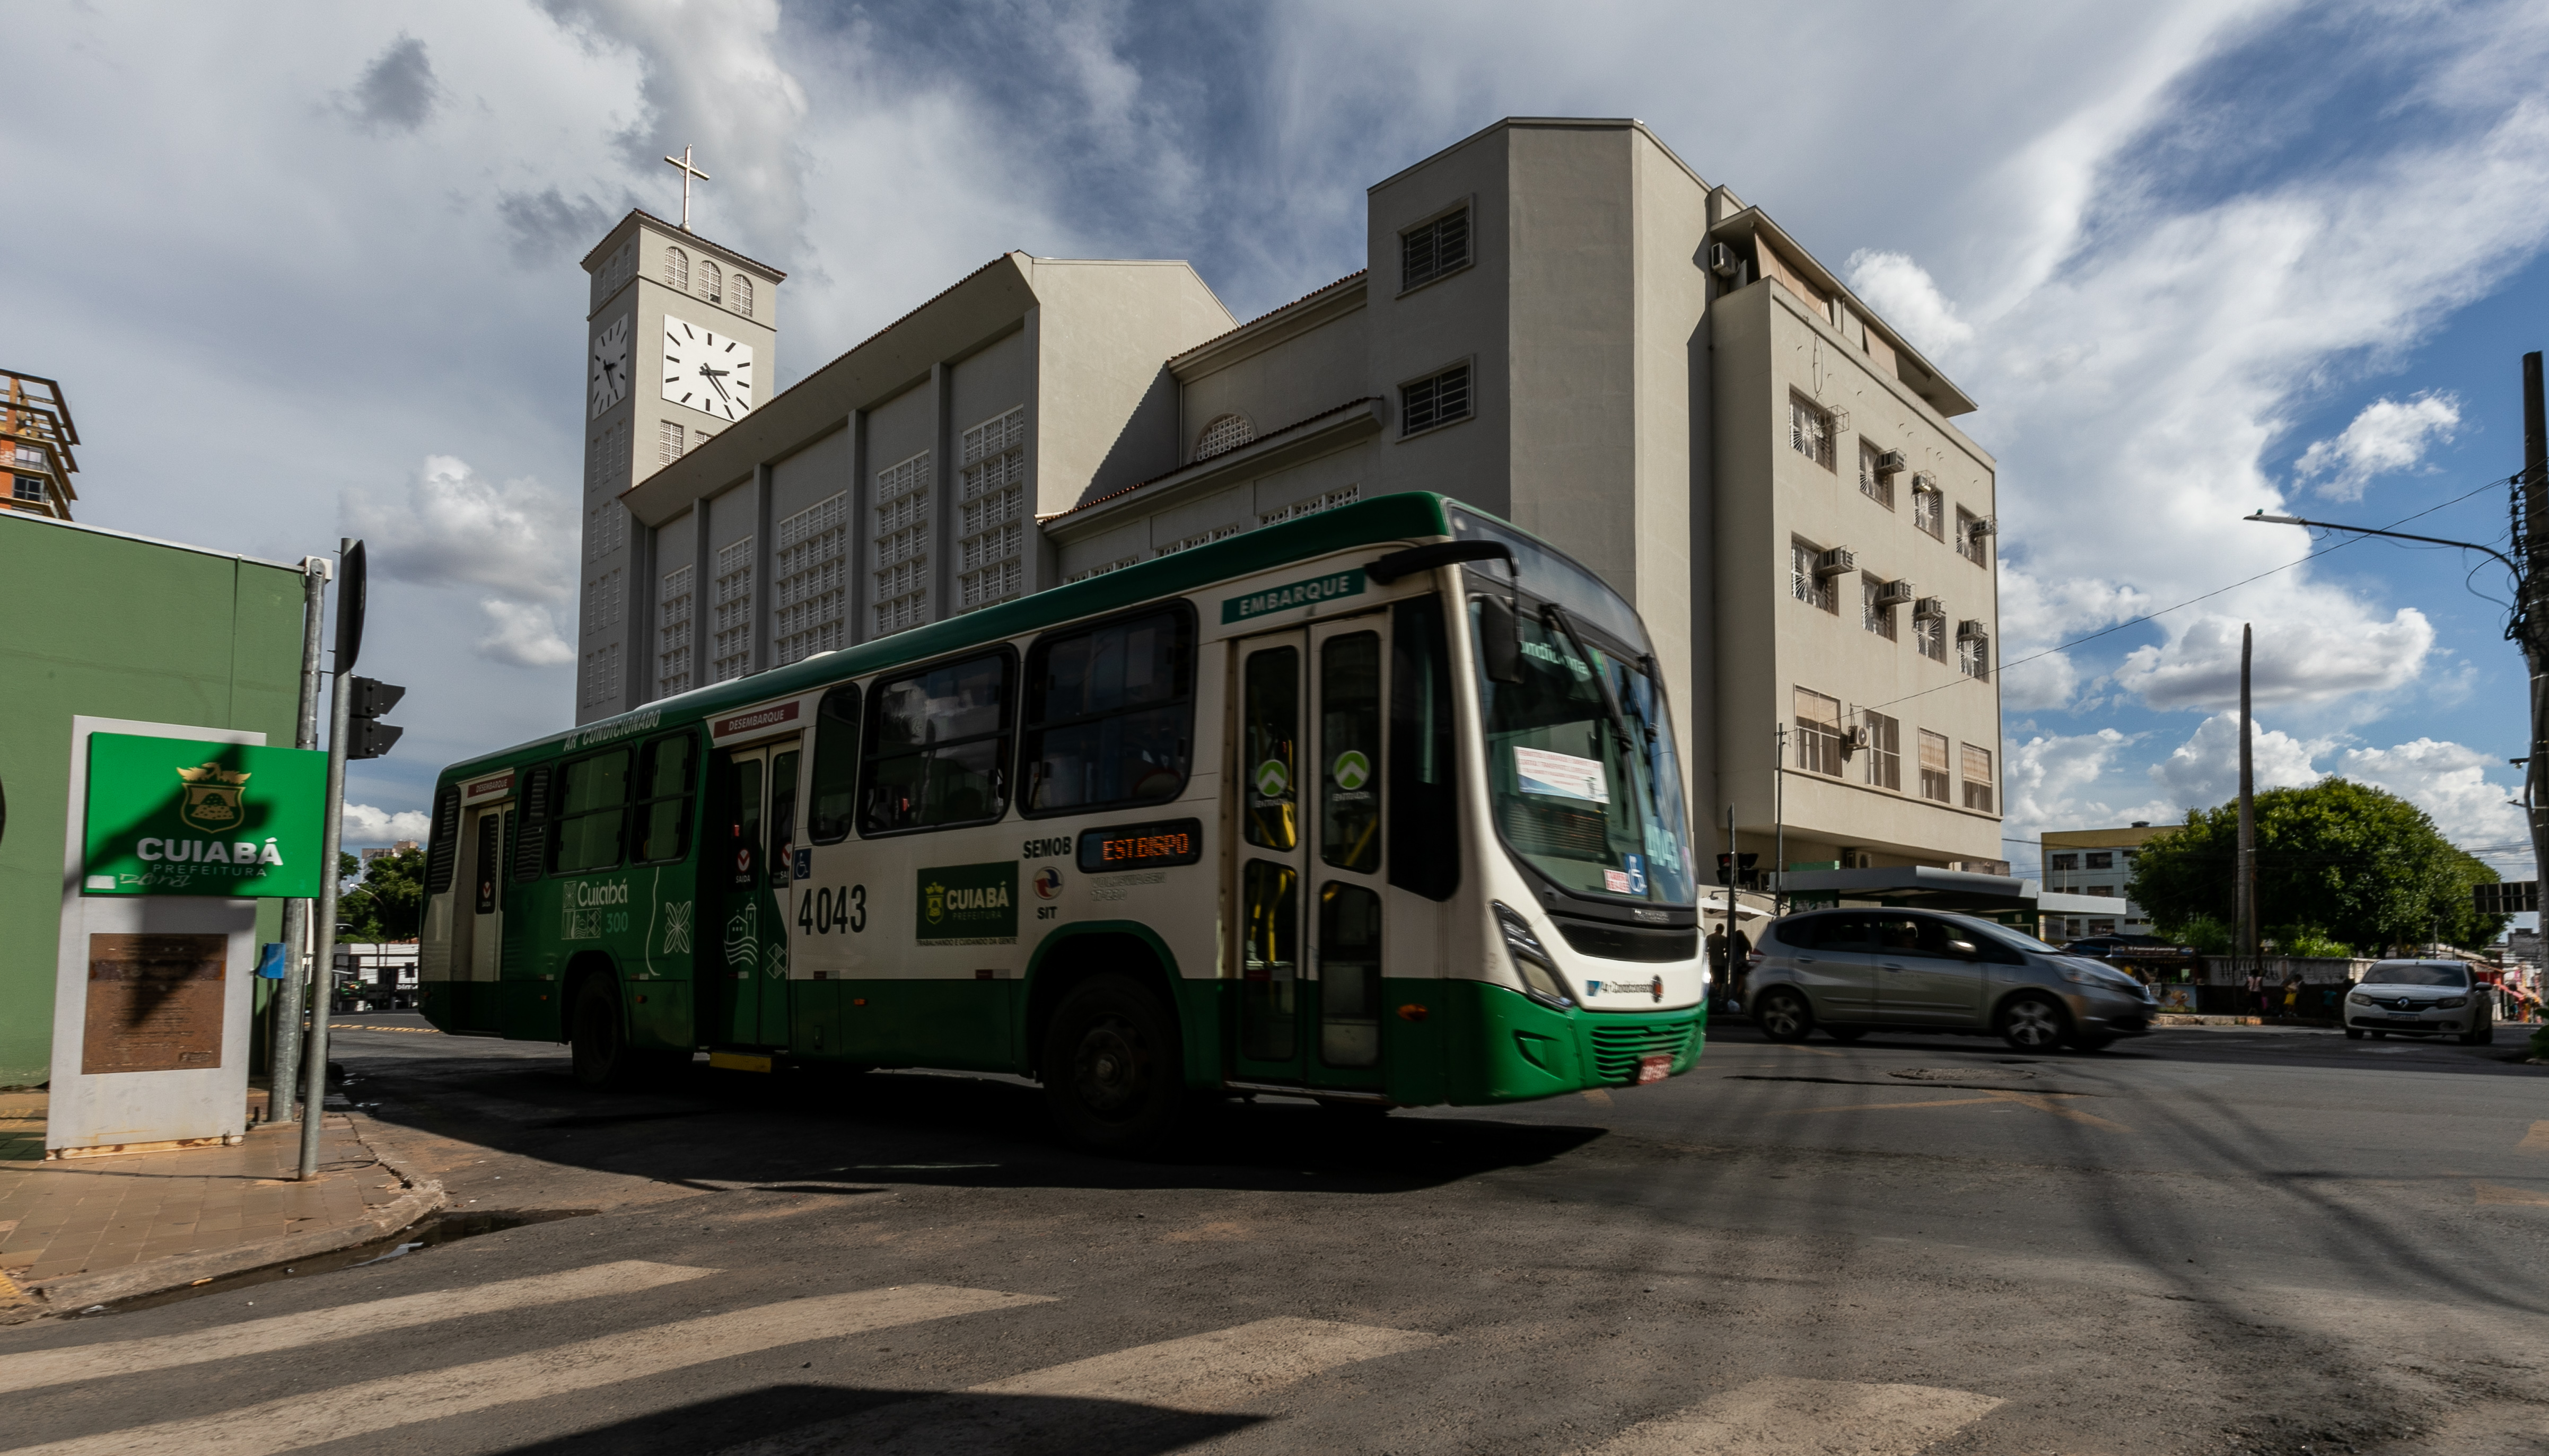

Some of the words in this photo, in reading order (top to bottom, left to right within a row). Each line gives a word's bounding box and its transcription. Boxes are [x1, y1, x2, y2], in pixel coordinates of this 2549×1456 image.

[1239, 575, 1350, 616] EMBARQUE
[563, 733, 579, 752] AR
[582, 709, 661, 745] CONDICIONADO
[729, 709, 784, 731] DESEMBARQUE
[476, 778, 507, 793] DESEMBARQUE
[136, 837, 284, 866] CUIABÁ
[1023, 837, 1072, 859] SEMOB
[153, 864, 267, 877] PREFEITURA
[577, 878, 628, 907] Cuiabá
[946, 880, 1010, 910] CUIABÁ
[798, 884, 866, 935] 4043
[952, 910, 1002, 920] PREFEITURA
[1037, 906, 1057, 919] SIT
[606, 911, 628, 933] 300
